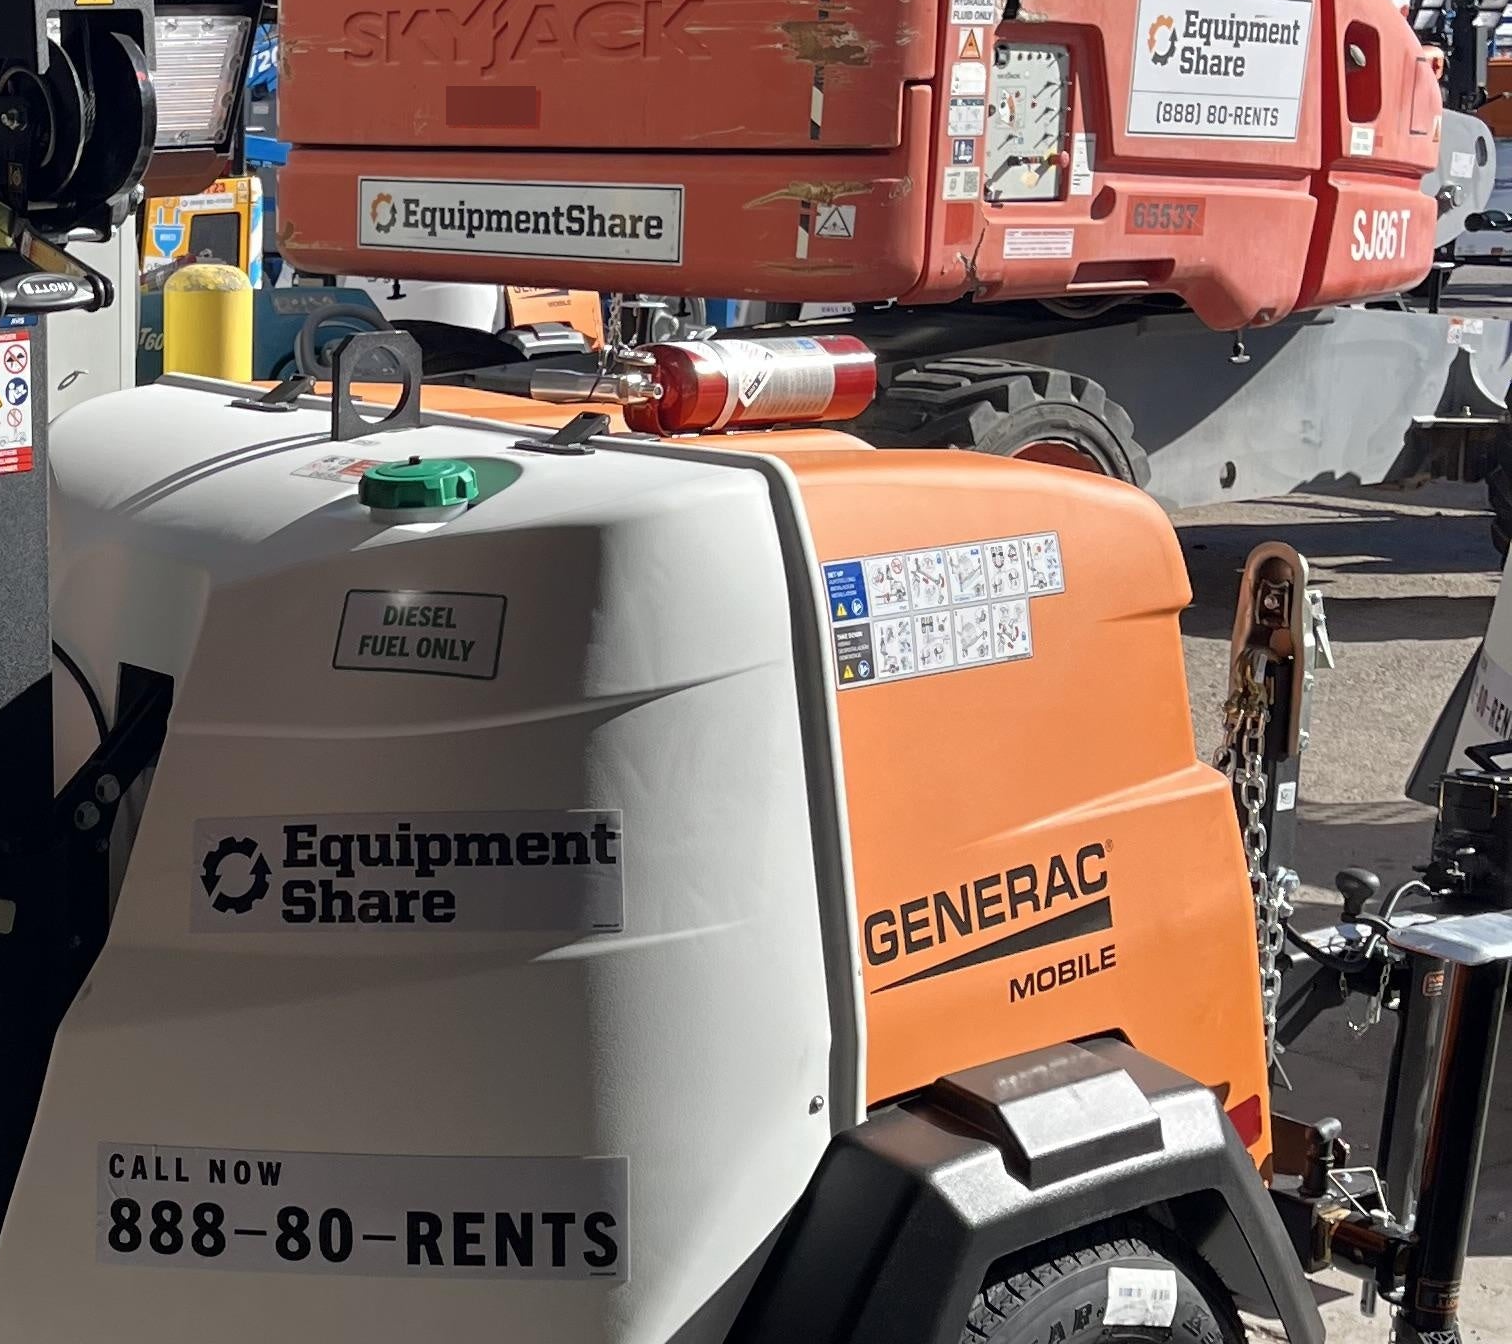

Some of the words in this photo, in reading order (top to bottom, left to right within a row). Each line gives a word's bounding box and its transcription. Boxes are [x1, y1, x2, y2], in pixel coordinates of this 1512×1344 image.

[952, 11, 973, 20] FLUID
[974, 11, 994, 20] ONLY
[1183, 9, 1300, 47] Equipment
[1179, 47, 1246, 78] Share
[1155, 101, 1202, 125] (888)
[1207, 103, 1280, 128] 80-RENTS
[403, 198, 663, 241] EquipmentShare
[1133, 203, 1200, 229] 65537
[34, 281, 75, 293] KNOTT
[382, 605, 457, 629] DIESEL
[359, 635, 411, 659] FUEL
[416, 636, 474, 662] ONLY
[283, 823, 618, 878] Equipment
[282, 878, 456, 924] Share
[864, 842, 1109, 966] GENERAC
[1009, 944, 1117, 1003] MOBILE
[108, 1153, 191, 1183] CALL
[208, 1159, 284, 1187] NOW
[107, 1196, 620, 1268] 888-80-RENTS
